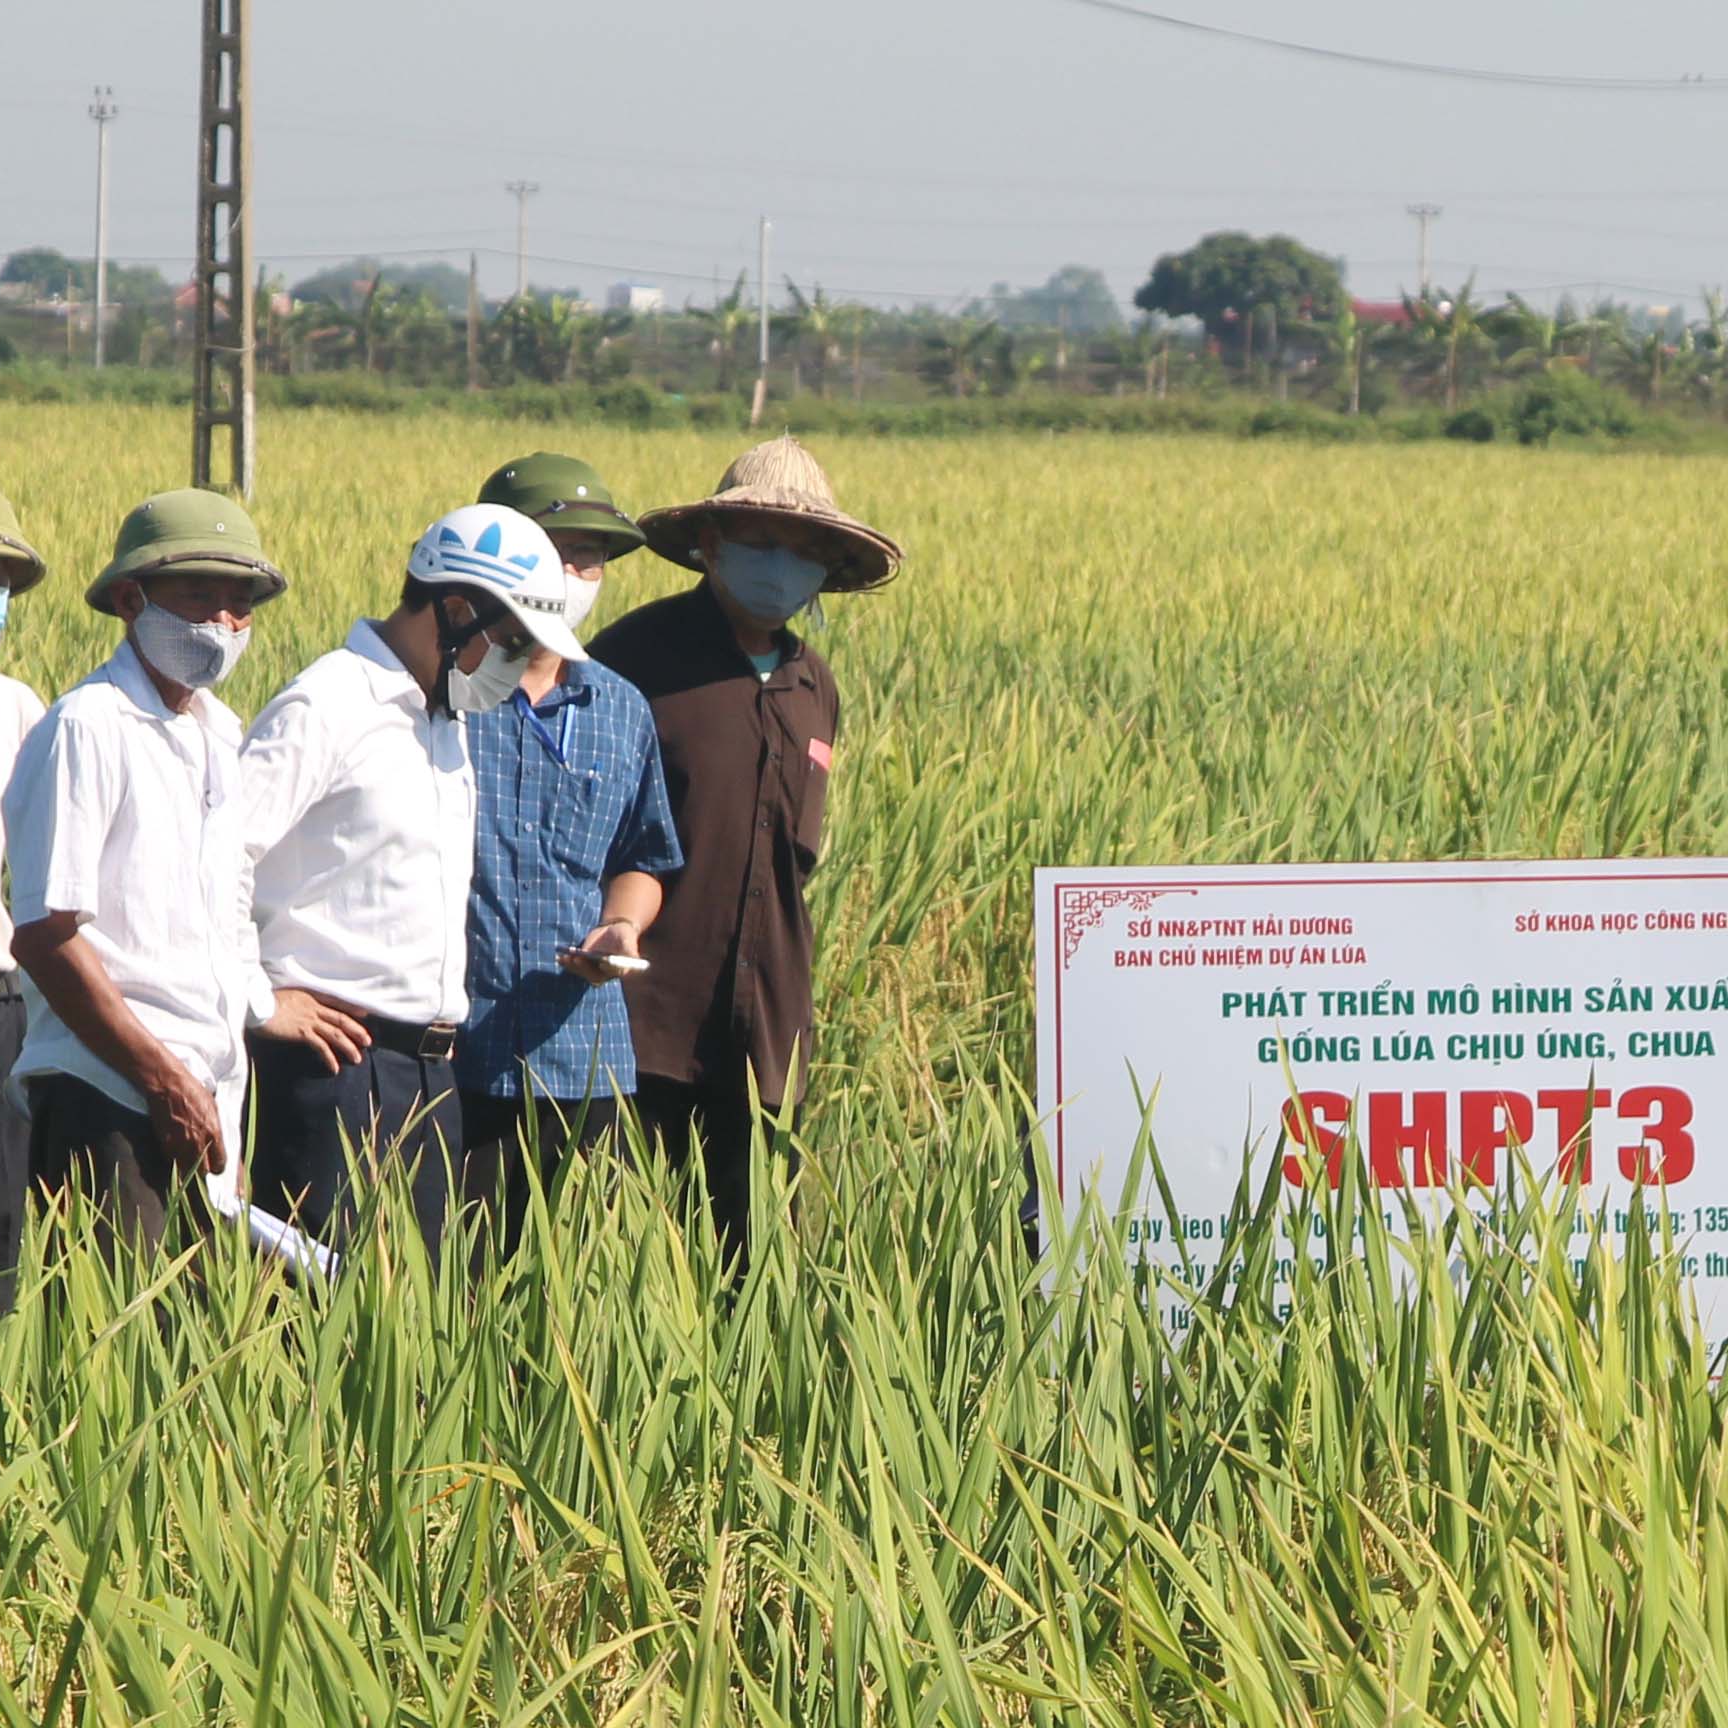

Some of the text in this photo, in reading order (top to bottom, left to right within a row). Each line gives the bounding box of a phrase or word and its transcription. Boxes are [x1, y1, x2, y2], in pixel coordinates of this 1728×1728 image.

[1126, 913, 1353, 938] SỞ NN&PTNT HẢI DƯƠNG
[1514, 908, 1540, 932] SỞ
[1545, 912, 1595, 931] KHOA
[1600, 912, 1638, 935] HỌC
[1644, 908, 1695, 930] CÔNG
[1114, 943, 1367, 970] BAN CHỦ NHIỆM DỰ ÁN LÚA
[1221, 985, 1307, 1018] PHÁT
[1318, 978, 1415, 1016] TRIỂN
[1427, 983, 1480, 1015] MÔ
[1492, 982, 1572, 1014] HÌNH
[1584, 977, 1653, 1014] SẢN
[1372, 1030, 1435, 1061] LÚA
[1446, 1033, 1525, 1065] CHỊU
[1536, 1027, 1616, 1061] ÚNG,
[1628, 1031, 1716, 1057] CHUA
[1281, 1085, 1695, 1189] SHPT3
